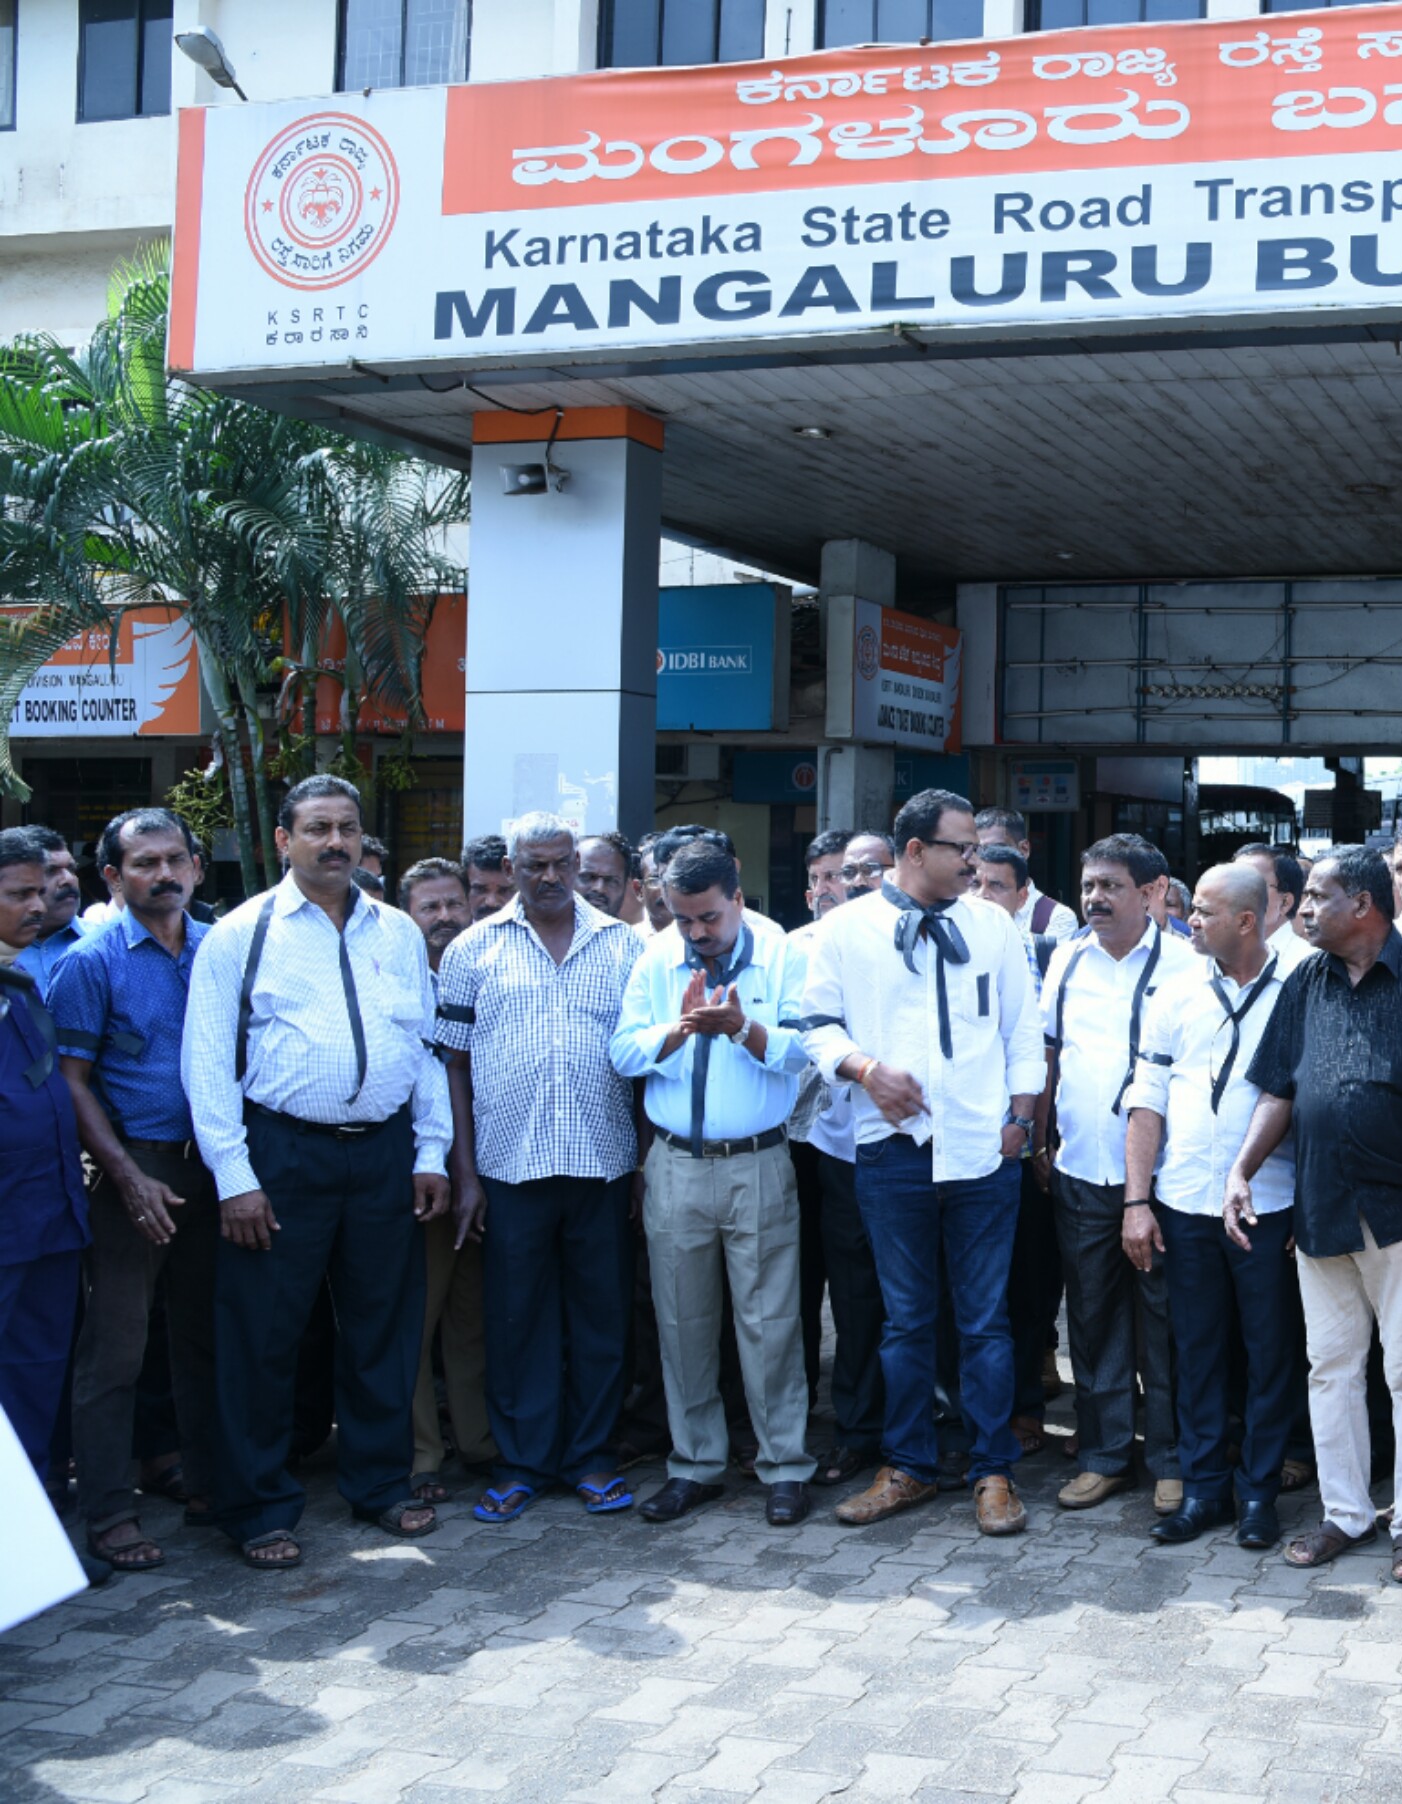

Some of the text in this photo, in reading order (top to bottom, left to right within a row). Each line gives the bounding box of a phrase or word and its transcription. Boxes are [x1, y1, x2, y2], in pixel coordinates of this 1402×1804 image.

[735, 51, 999, 104] ಕರ್ನಾಟಕ
[1032, 45, 1178, 86] ರಾಜ್ಯ
[1218, 27, 1323, 74] ರಸ್ತೆ
[511, 87, 1192, 186] ಮಂಗಳೂರು
[485, 215, 762, 269] Karnataka
[800, 203, 951, 247] State
[994, 184, 1153, 234] Road
[433, 242, 1212, 339] MANGALURU
[669, 652, 748, 670] IDBI BANK
[25, 700, 77, 723] BOOKING
[82, 698, 138, 722] COUNTER
